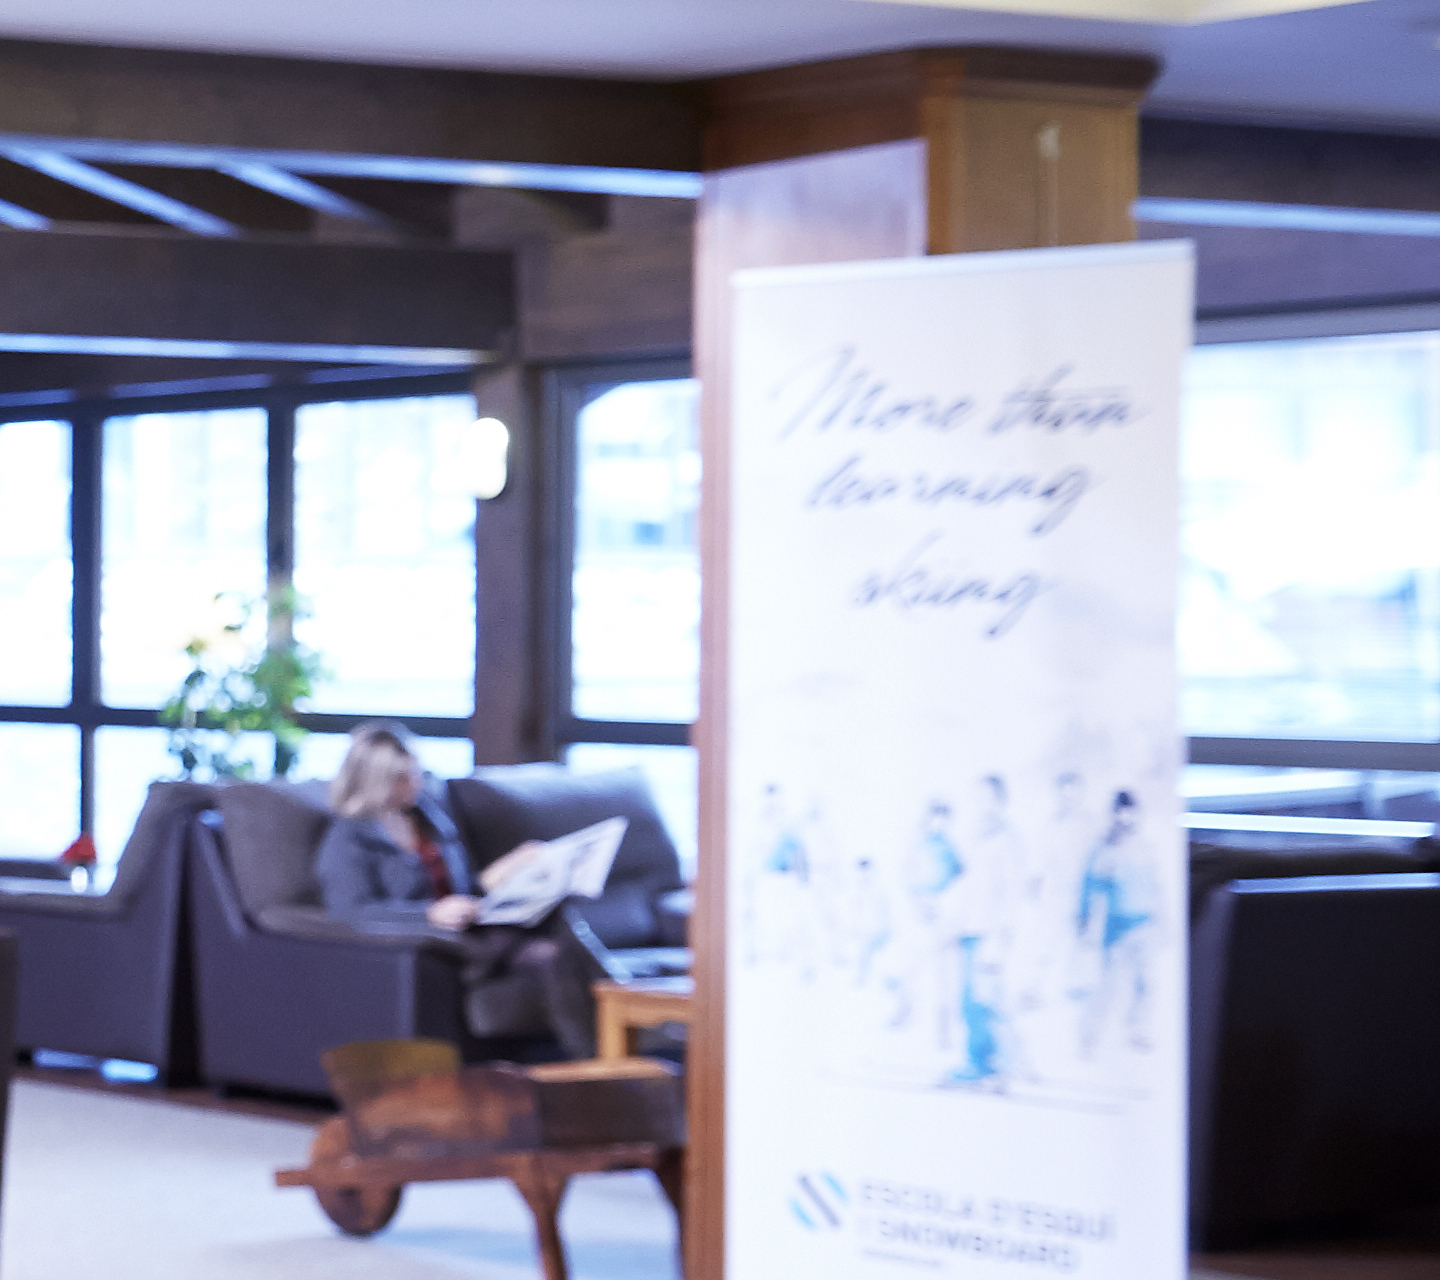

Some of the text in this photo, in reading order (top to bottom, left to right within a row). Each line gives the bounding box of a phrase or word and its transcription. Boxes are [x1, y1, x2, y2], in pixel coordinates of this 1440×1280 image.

[768, 341, 1150, 443] More than
[805, 451, 1107, 538] learning
